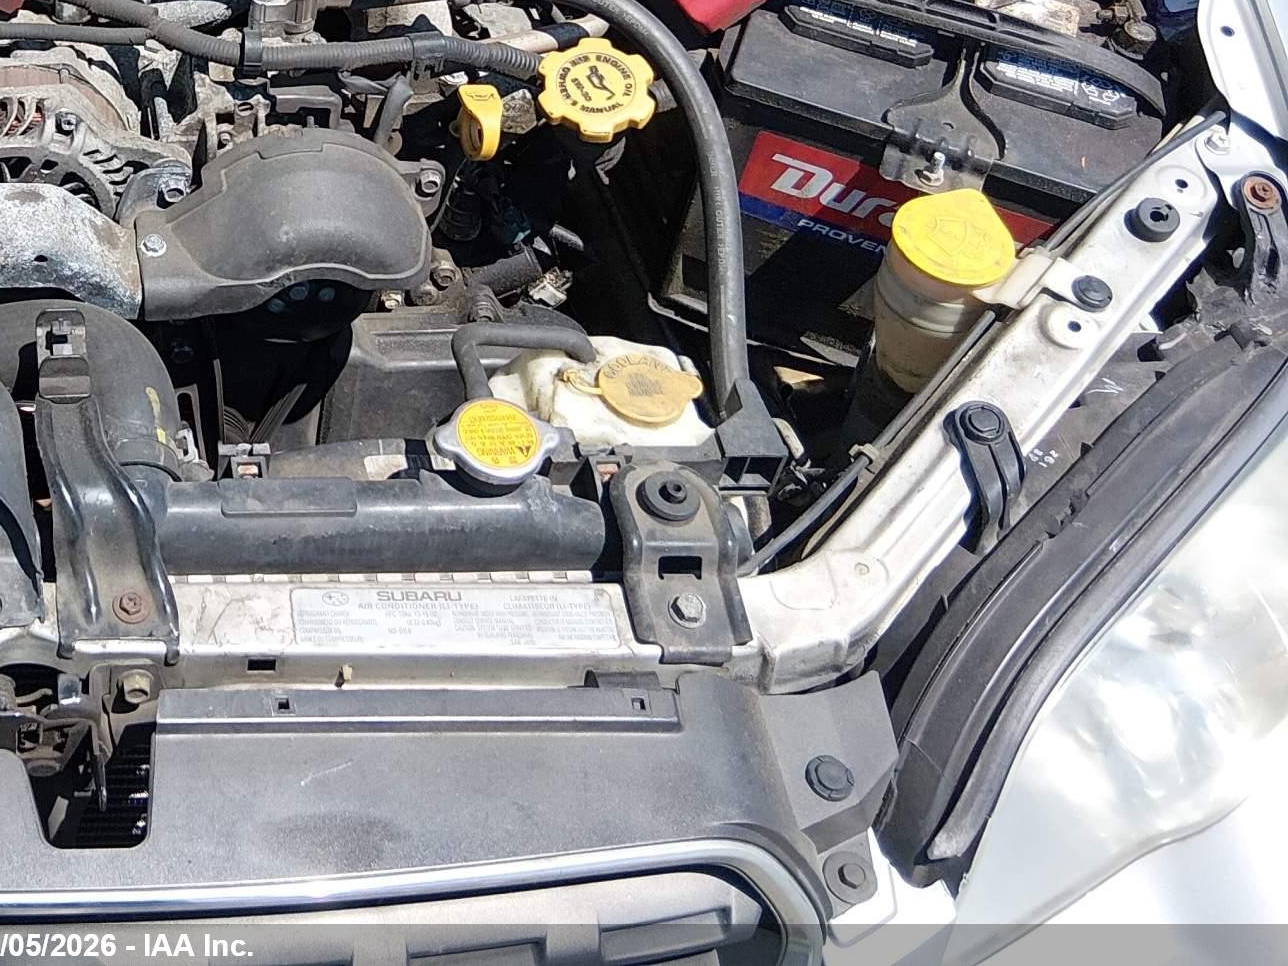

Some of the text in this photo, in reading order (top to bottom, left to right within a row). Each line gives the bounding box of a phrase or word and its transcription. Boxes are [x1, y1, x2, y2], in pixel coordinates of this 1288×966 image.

[595, 54, 634, 97] ENGINE OIL
[578, 101, 624, 114] MANUAL
[376, 590, 462, 602] SUBARU
[357, 602, 373, 610] AIR
[375, 602, 438, 611] CONDITIONER
